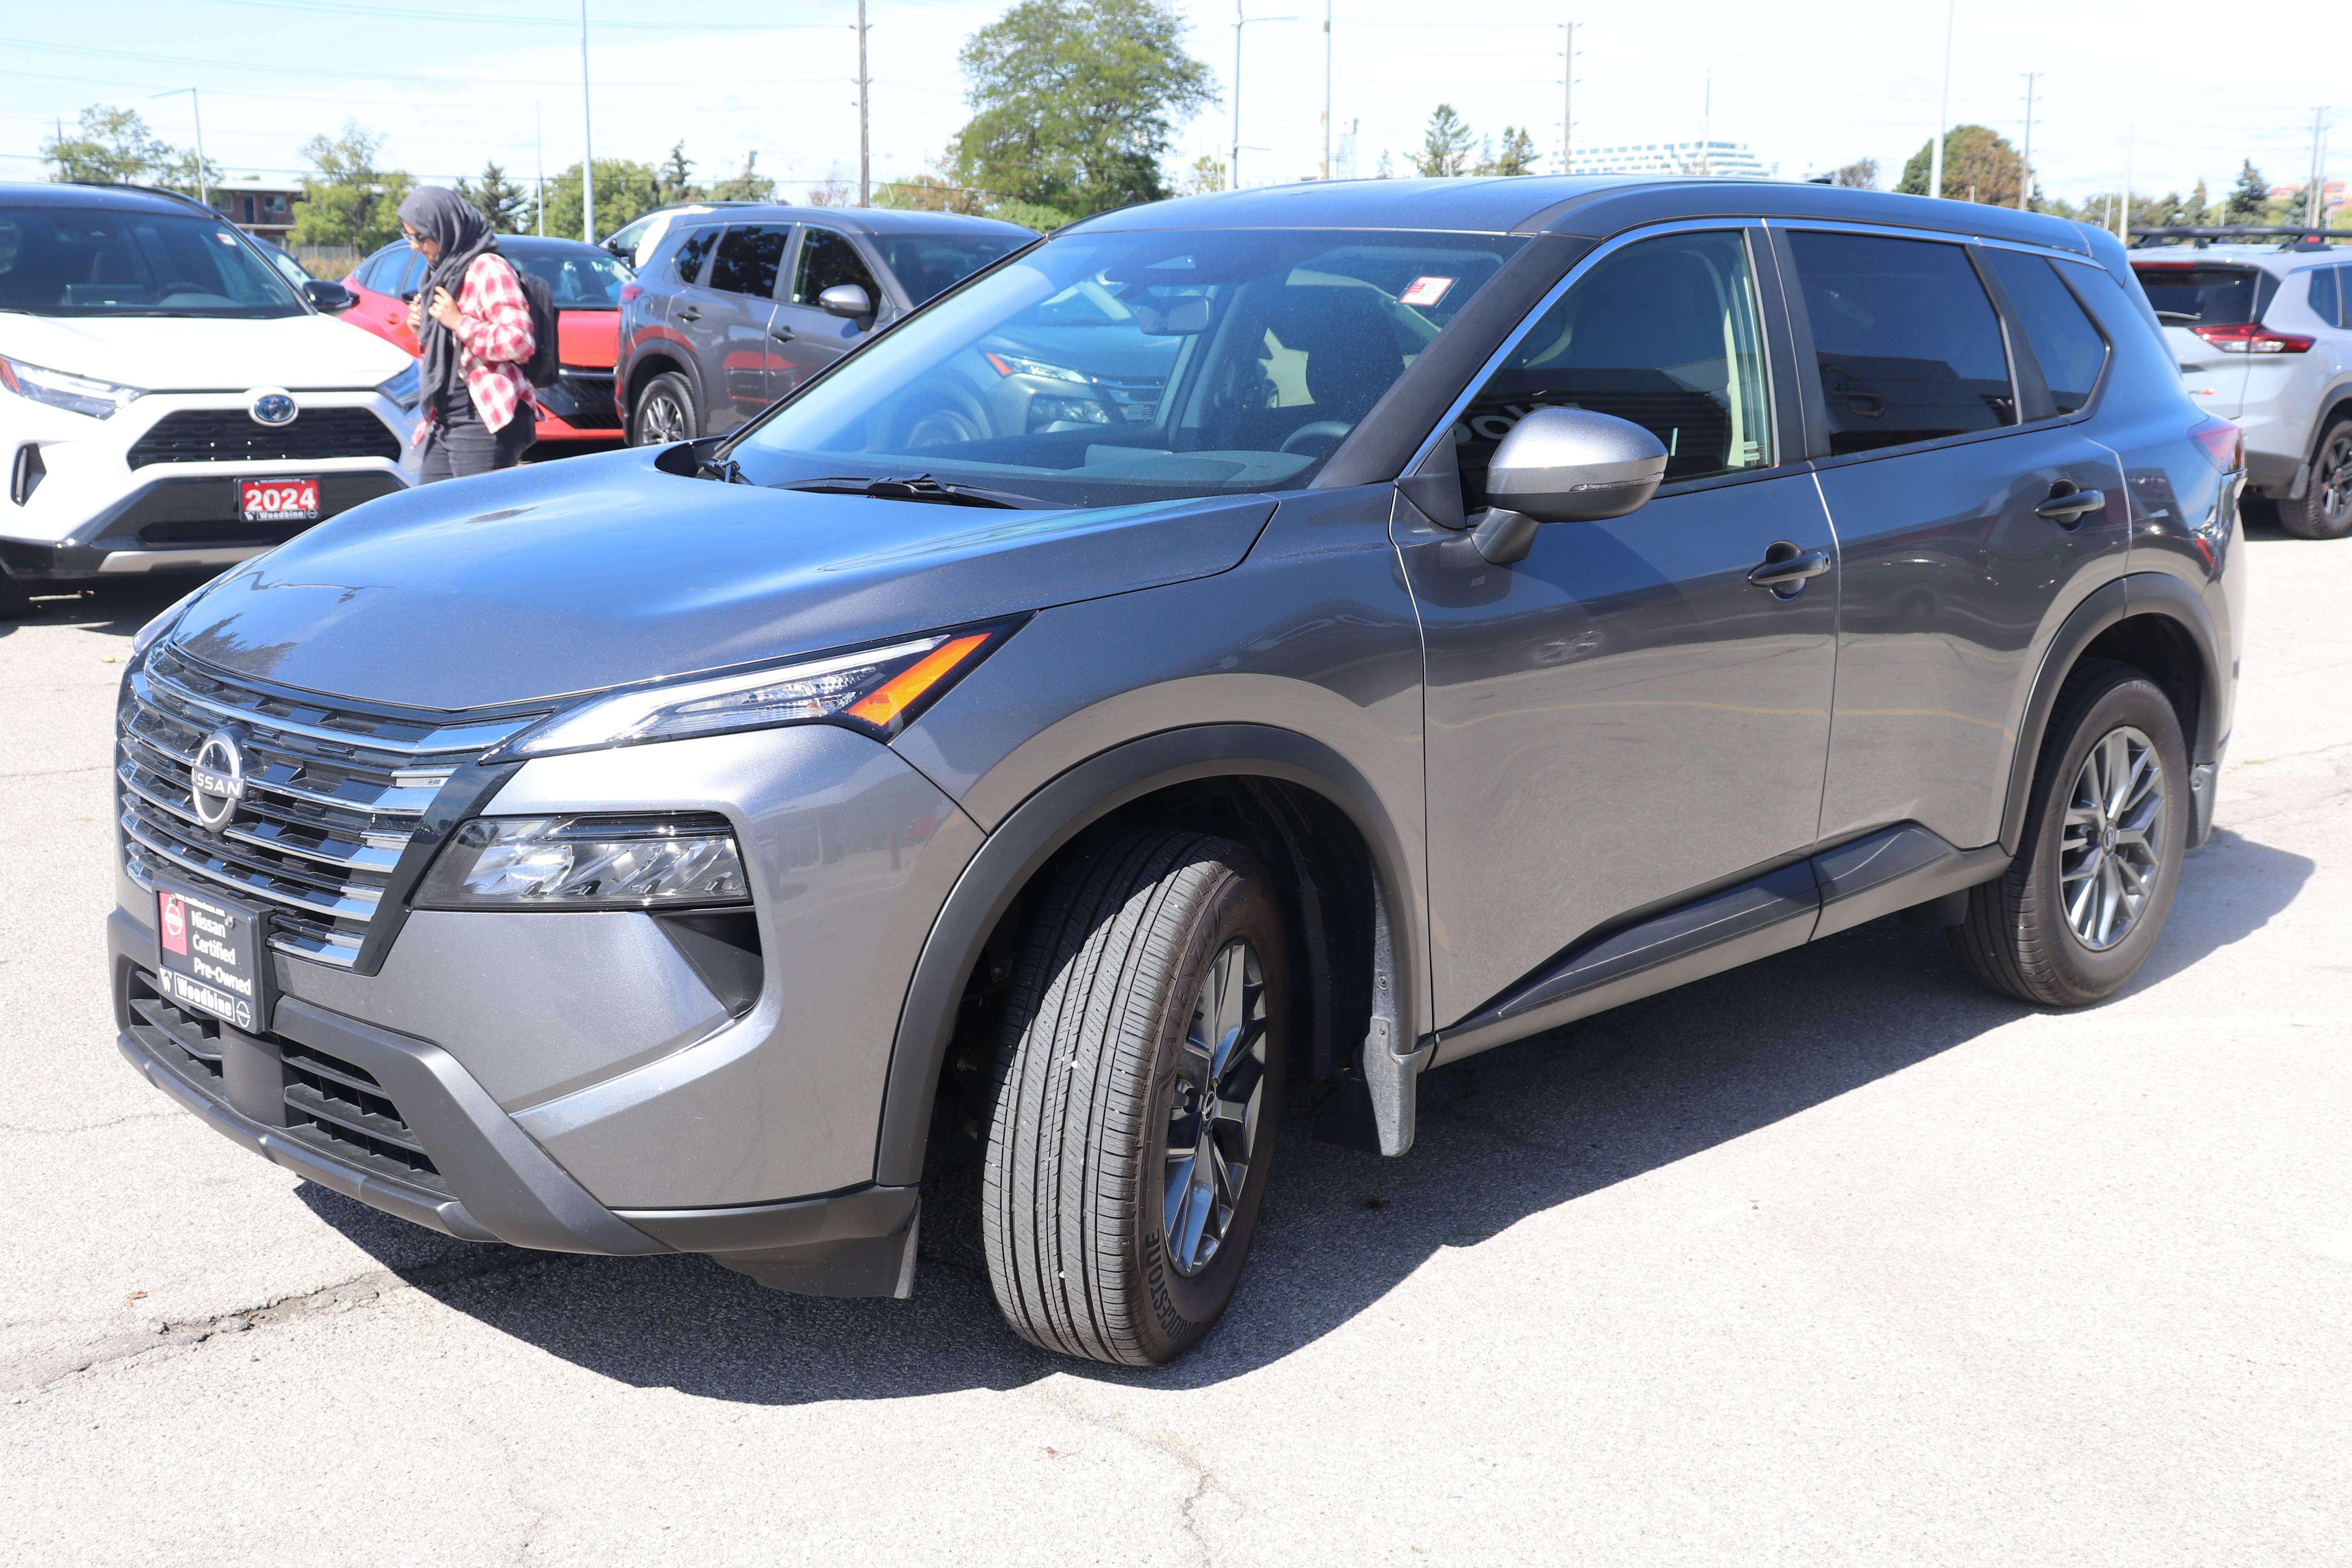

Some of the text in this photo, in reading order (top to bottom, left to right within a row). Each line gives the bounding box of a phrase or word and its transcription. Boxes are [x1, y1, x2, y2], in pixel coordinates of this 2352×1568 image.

[245, 487, 316, 511] 2024
[260, 510, 303, 519] Woodbine
[191, 767, 241, 795] NISSAN
[191, 910, 226, 938] Nissan
[192, 933, 236, 965] Certified
[194, 957, 251, 996] Pre-Owned
[177, 976, 232, 1016] Woodbine
[1145, 1228, 1201, 1342] BRIDGESTONE
